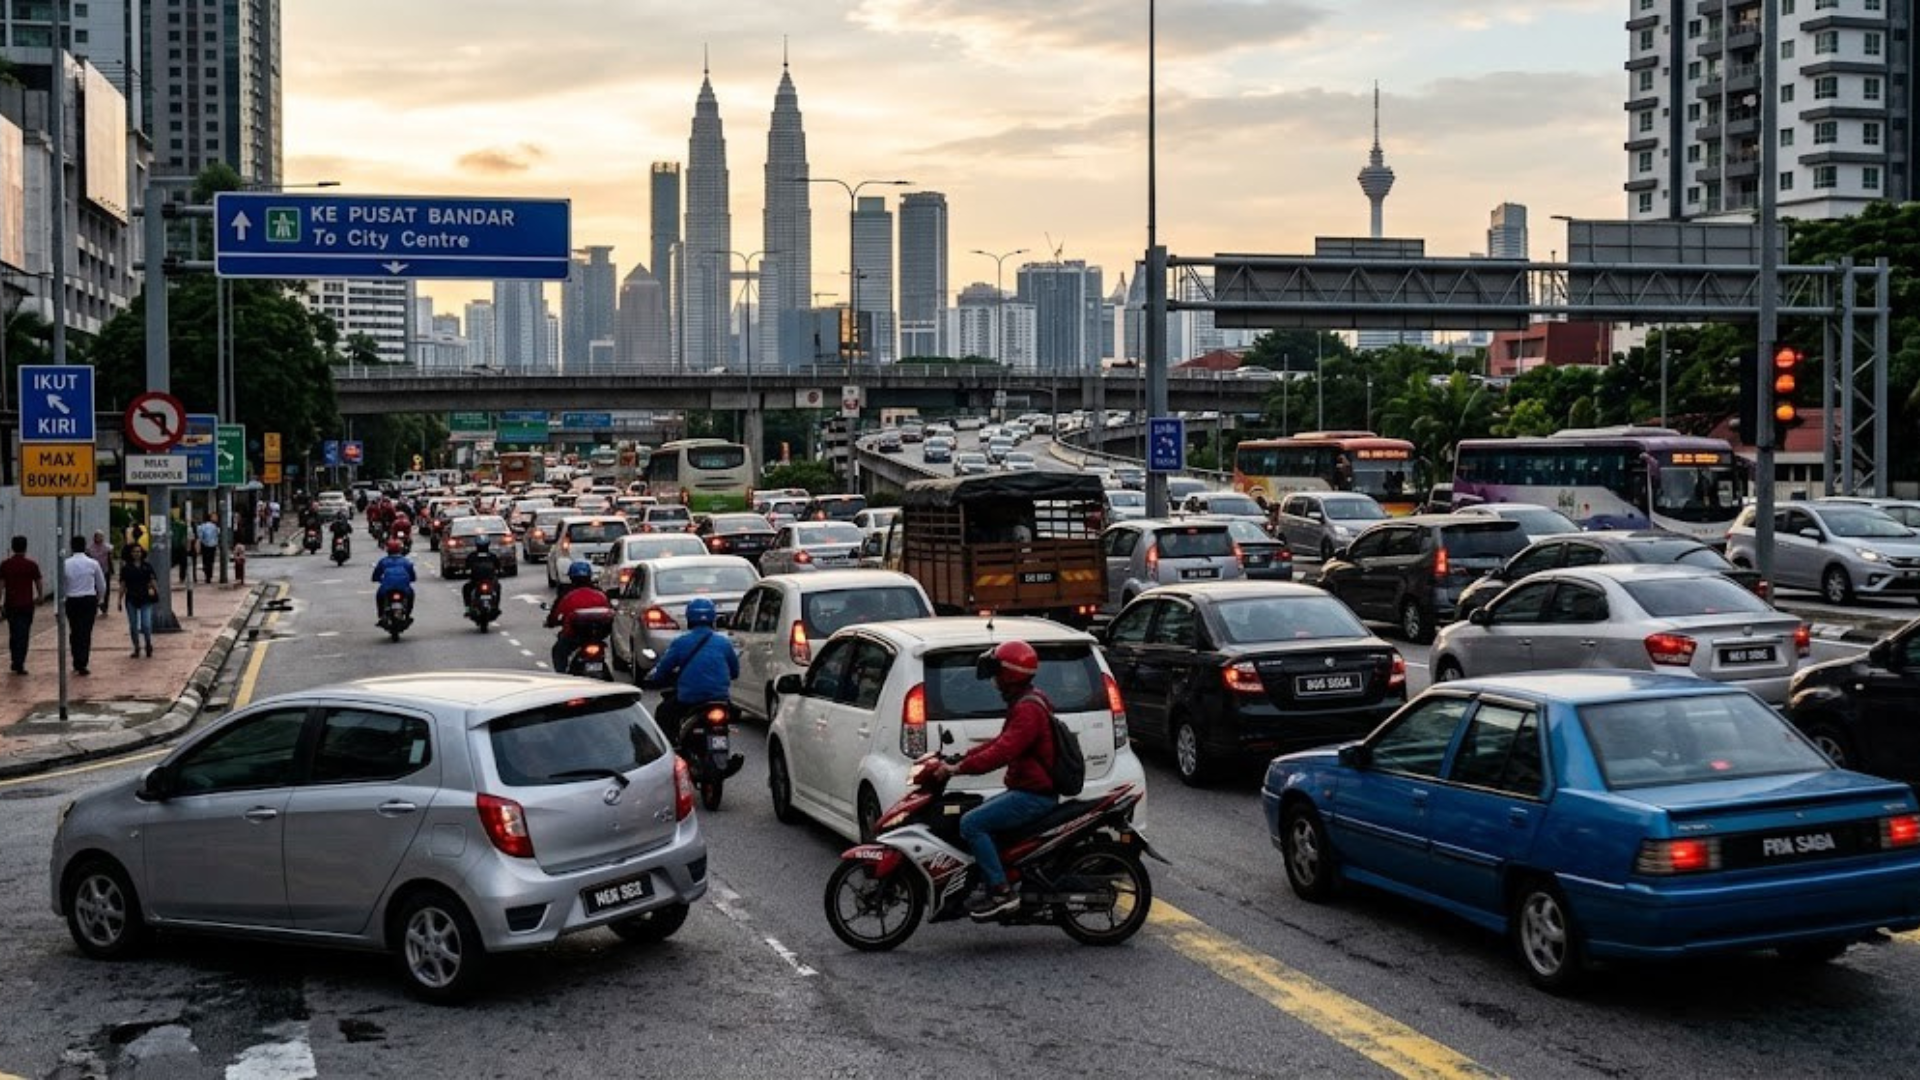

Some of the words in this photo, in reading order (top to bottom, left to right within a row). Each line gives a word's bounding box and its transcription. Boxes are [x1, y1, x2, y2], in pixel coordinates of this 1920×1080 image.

[310, 206, 337, 223] KE
[349, 206, 417, 224] PUSAT
[428, 208, 514, 225] BANDAR
[312, 228, 337, 245] To
[347, 229, 389, 249] City
[401, 230, 470, 248] Centre
[34, 374, 78, 390] IKUT
[37, 418, 76, 434] KIRI
[39, 452, 76, 467] MAX
[27, 473, 89, 488] 80KM/J
